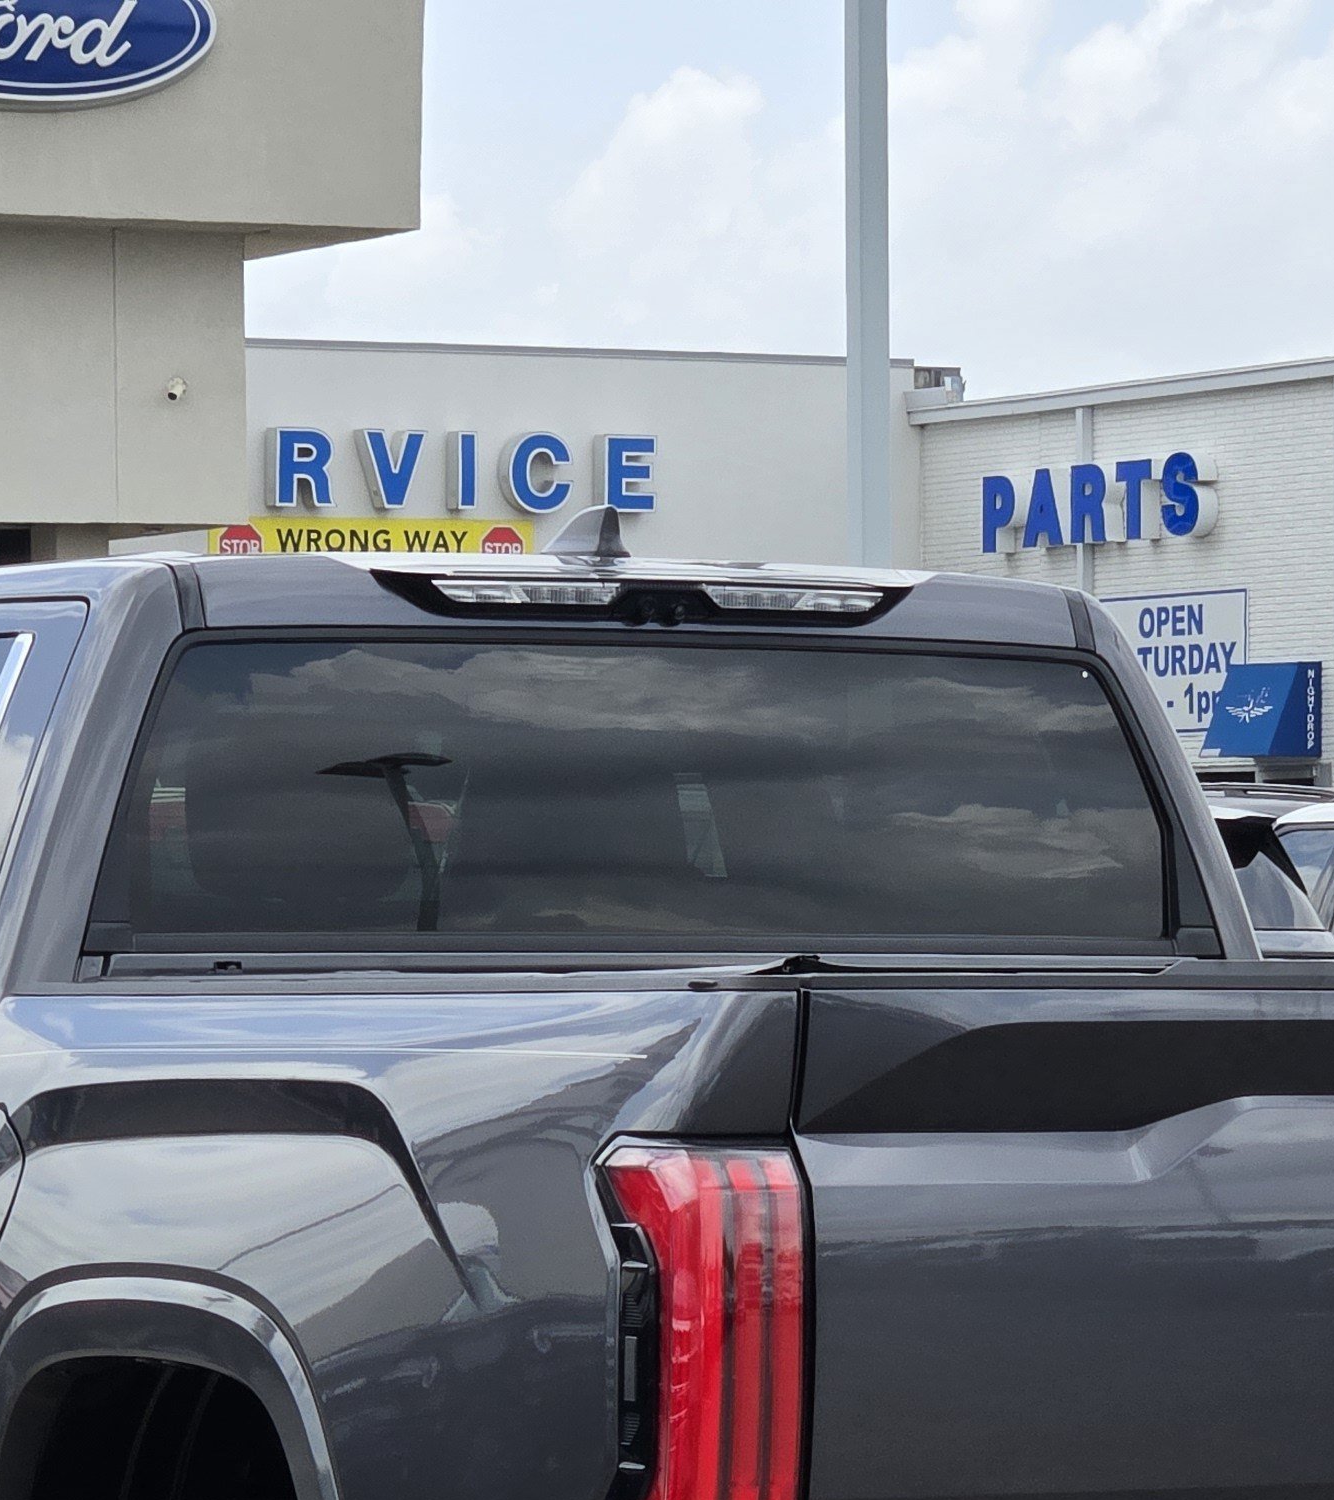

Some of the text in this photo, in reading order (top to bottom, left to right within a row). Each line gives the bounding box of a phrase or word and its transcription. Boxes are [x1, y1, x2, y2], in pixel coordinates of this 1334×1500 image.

[982, 451, 1200, 553] PARTS
[276, 528, 468, 553] WRONG WAY
[1138, 603, 1204, 638] OPEN
